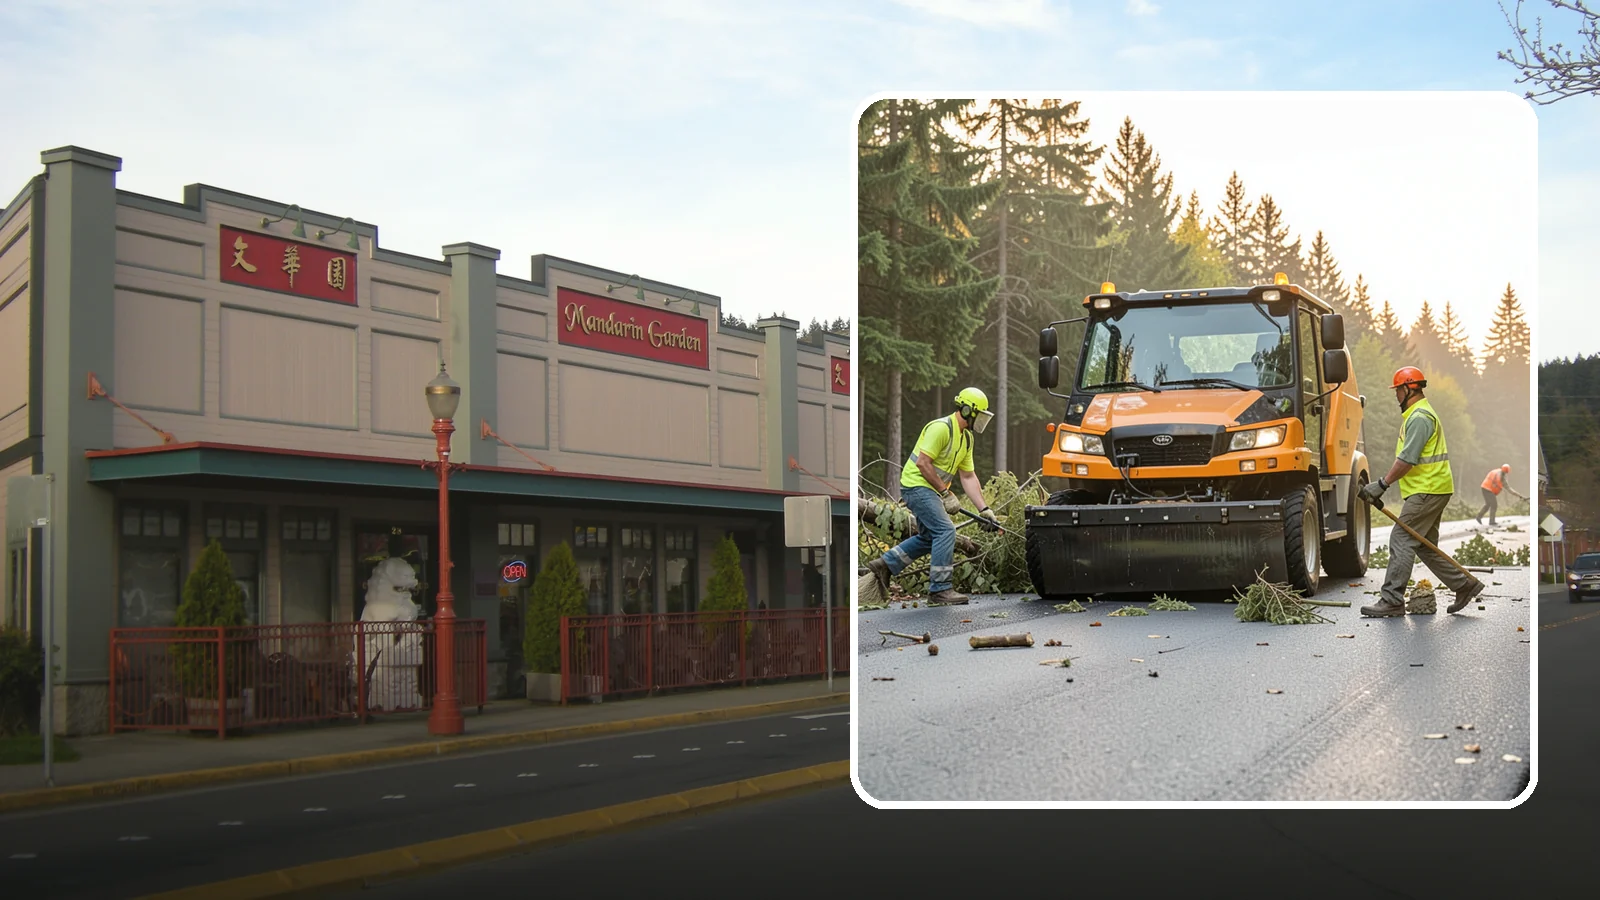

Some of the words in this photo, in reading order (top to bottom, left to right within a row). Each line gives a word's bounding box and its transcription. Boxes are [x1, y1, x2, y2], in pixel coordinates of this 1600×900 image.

[231, 236, 346, 291] 文華園
[564, 302, 644, 341] Mandarin
[648, 320, 701, 352] Garden
[503, 565, 527, 578] OPEN
